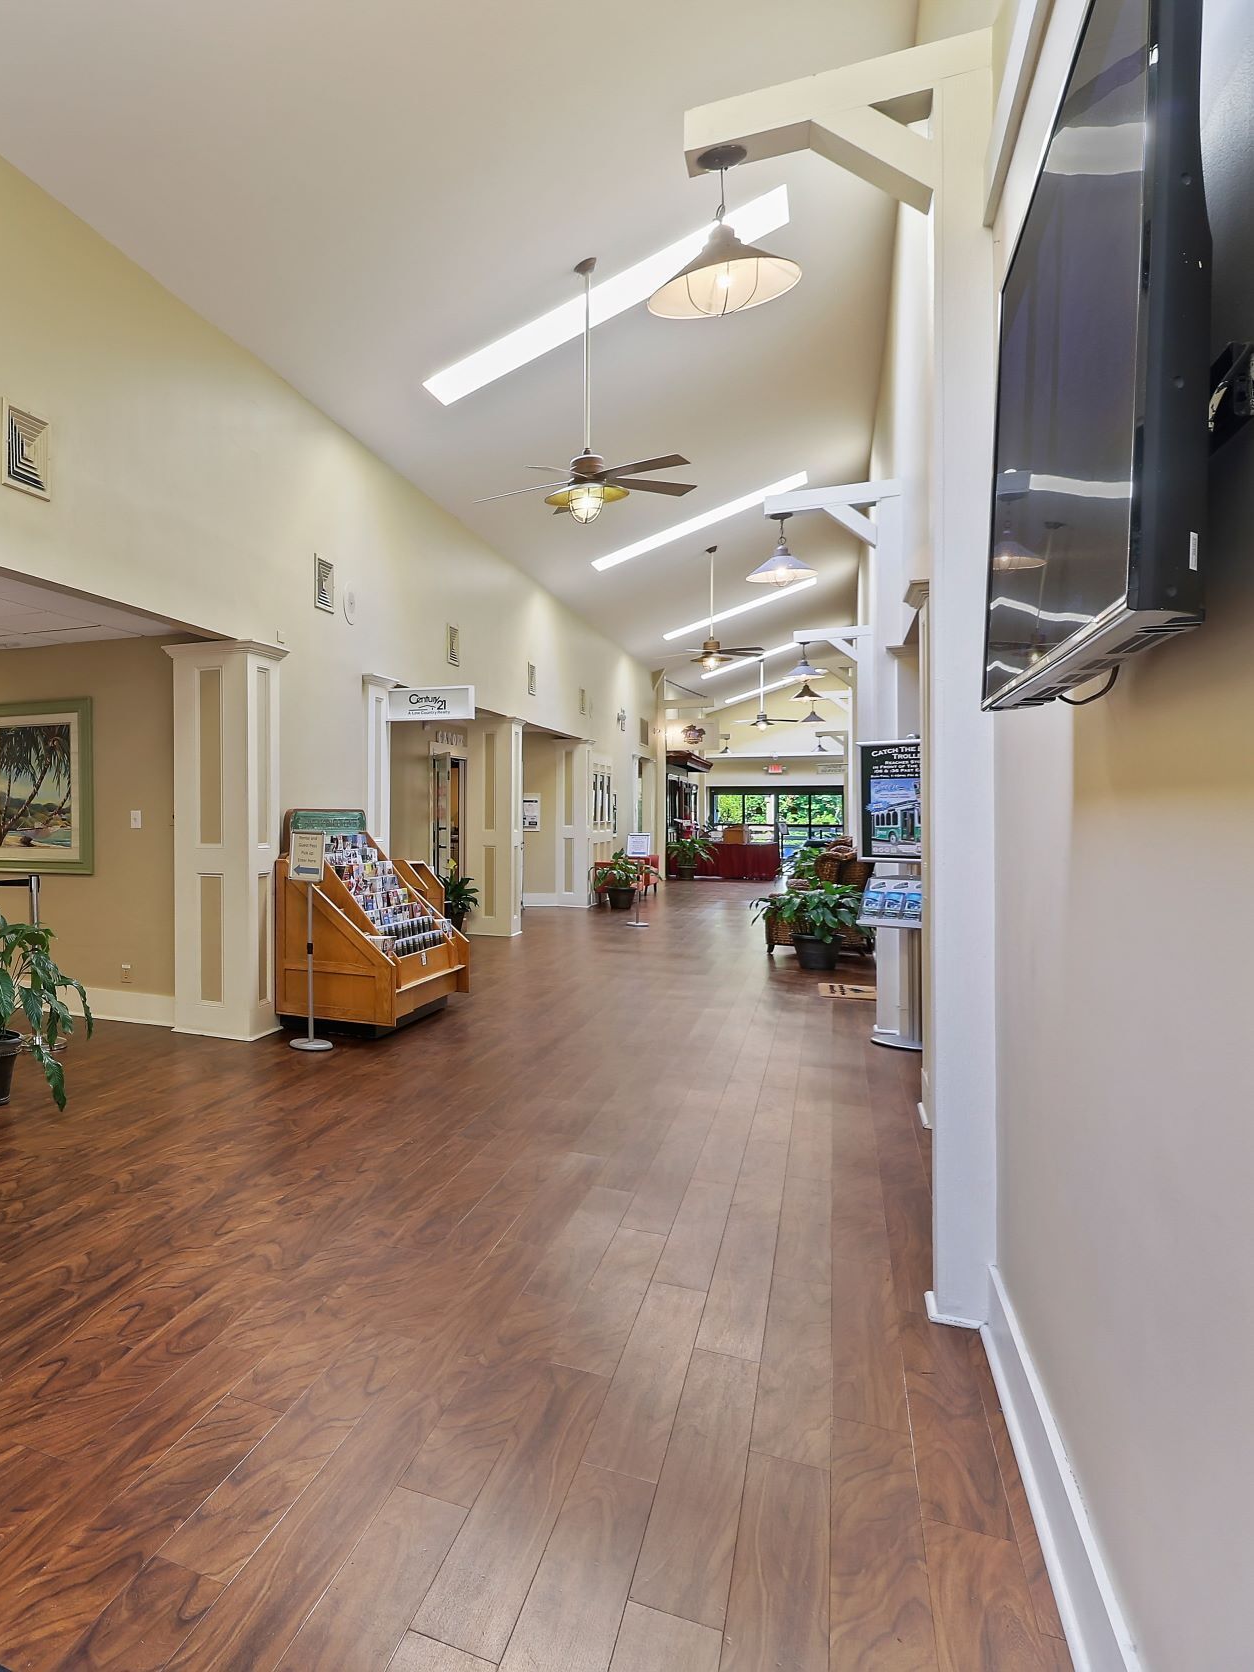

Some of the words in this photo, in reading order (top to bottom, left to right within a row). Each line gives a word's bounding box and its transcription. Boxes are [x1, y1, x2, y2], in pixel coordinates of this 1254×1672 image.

[408, 693, 440, 704] Century
[437, 699, 447, 710] 21
[871, 747, 898, 757] CATCH
